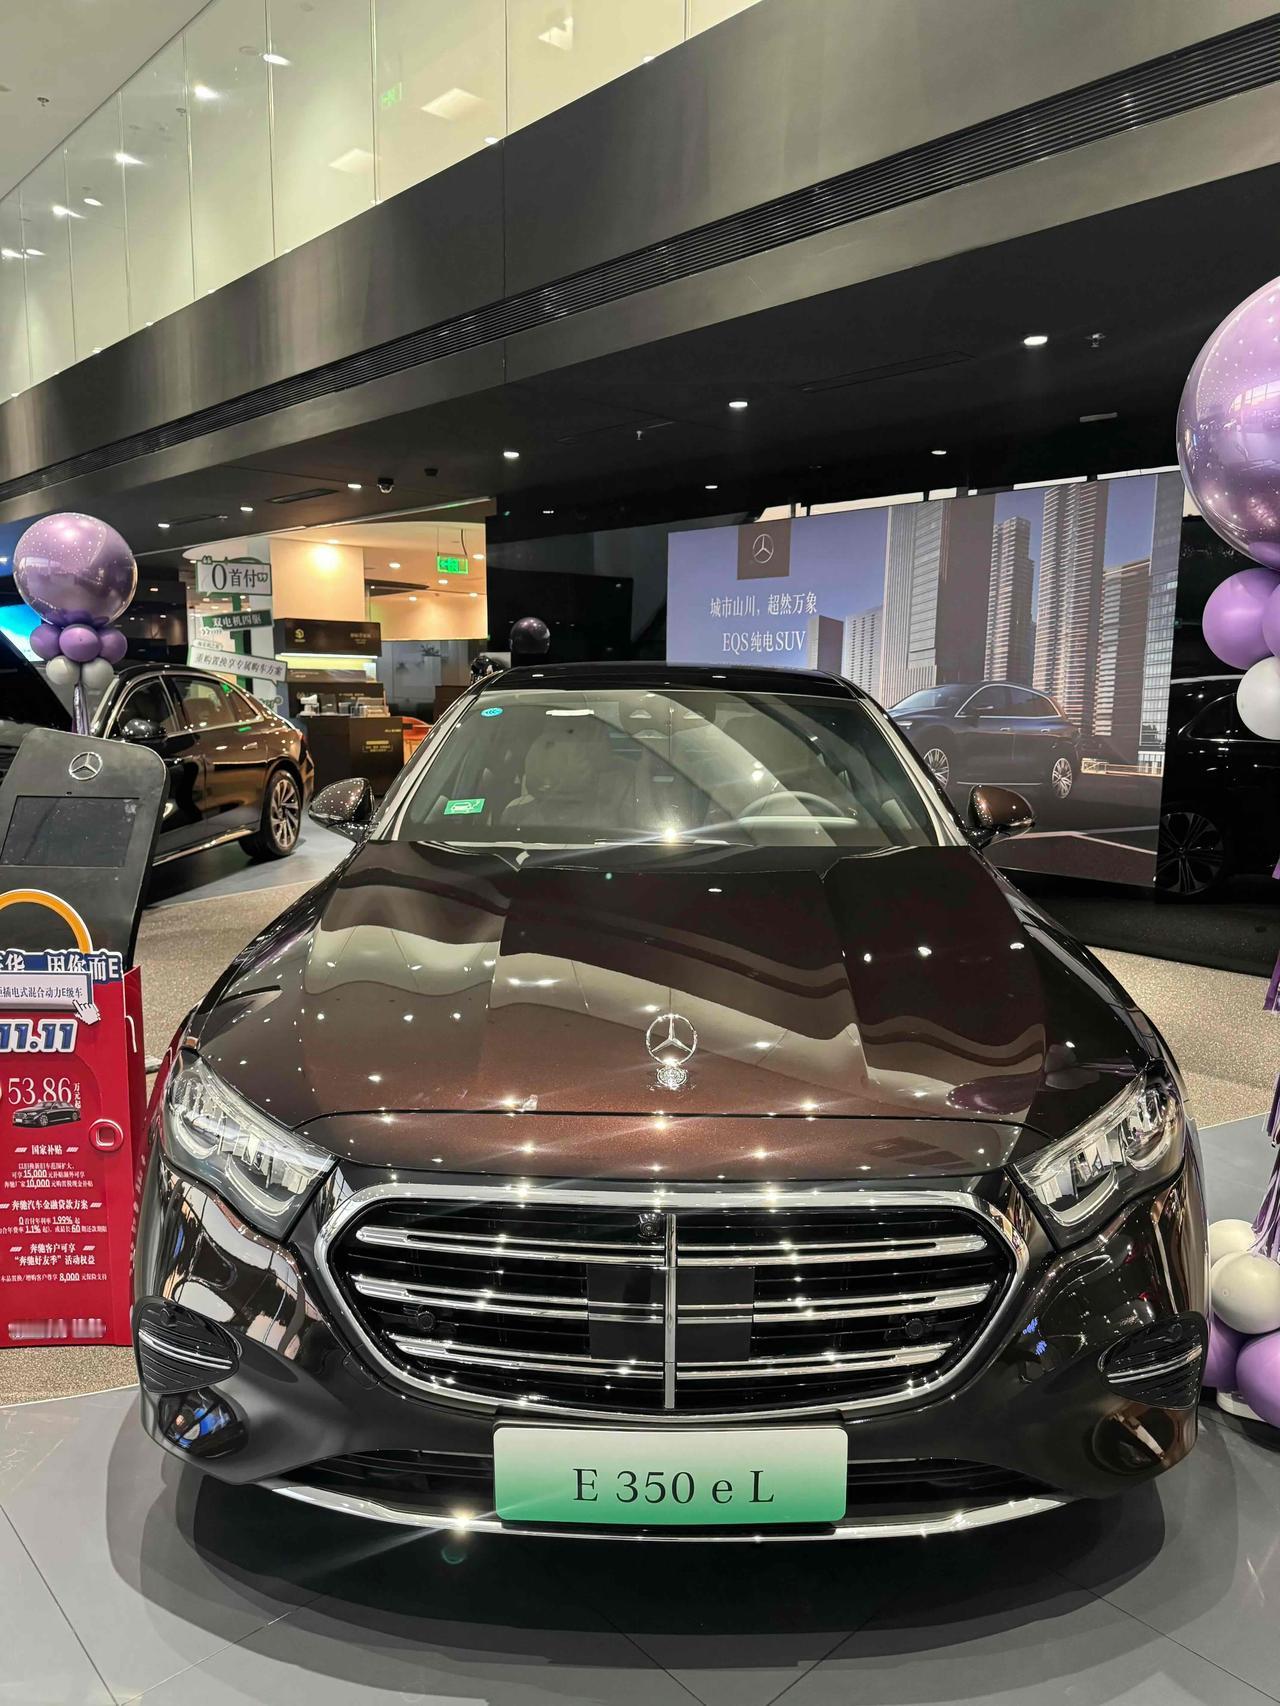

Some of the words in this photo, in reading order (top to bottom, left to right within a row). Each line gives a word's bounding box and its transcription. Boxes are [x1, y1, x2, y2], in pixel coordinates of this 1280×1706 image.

[0, 953, 25, 971] 华
[8, 1077, 72, 1105] 53.86
[31, 1144, 63, 1155] 国家补贴
[12, 1199, 88, 1211] 奔驰汽车金融贷款方案
[30, 1243, 76, 1254] 奔驰客户可享
[572, 1467, 598, 1502] E
[616, 1470, 695, 1504] 350
[711, 1478, 733, 1504] e
[748, 1469, 775, 1503] L
